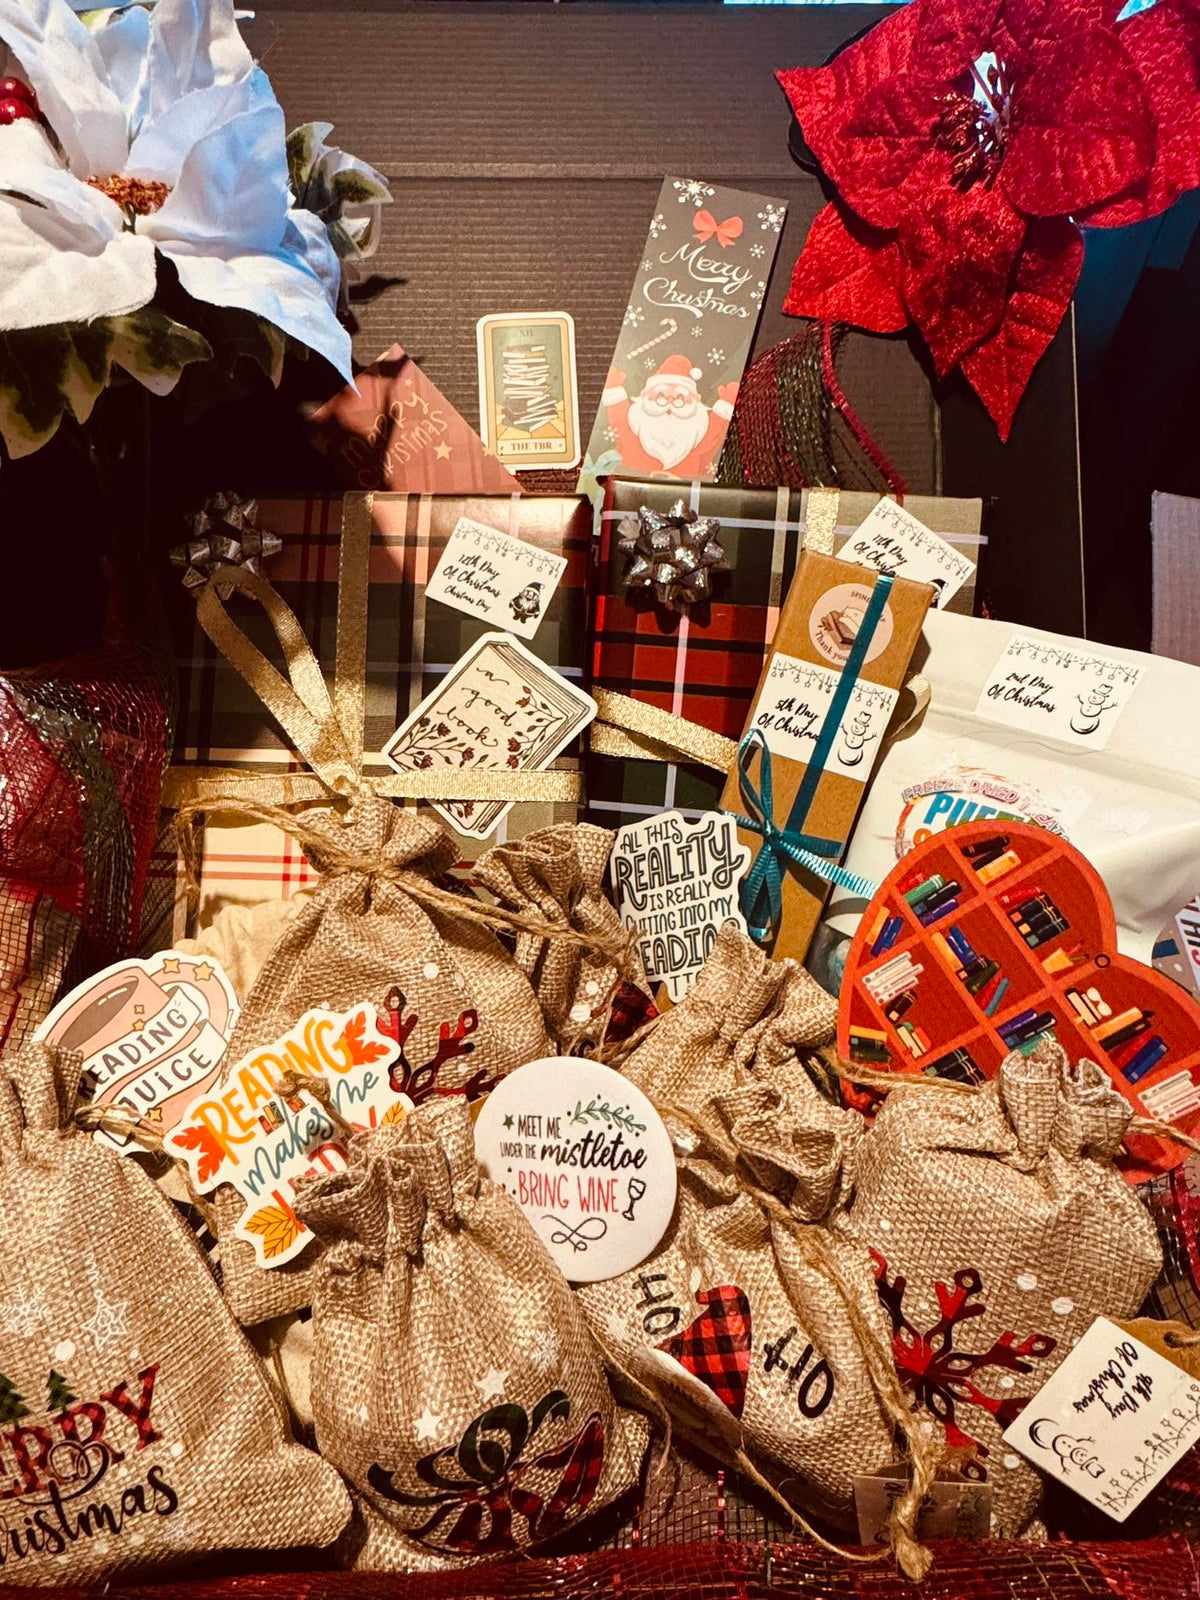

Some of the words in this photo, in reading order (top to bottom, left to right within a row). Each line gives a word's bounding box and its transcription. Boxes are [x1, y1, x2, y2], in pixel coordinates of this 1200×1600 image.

[659, 243, 753, 295] Merry
[643, 277, 751, 319] Christmas
[519, 328, 533, 337] XII
[511, 442, 531, 451] THE
[533, 441, 552, 450] TBR
[853, 541, 871, 555] Of
[888, 545, 907, 566] Day
[442, 565, 459, 580] Of
[456, 570, 502, 598] Christmas
[458, 554, 482, 567] 12th
[478, 560, 501, 581] Day
[815, 630, 833, 655] Thank
[476, 667, 510, 686] a
[1027, 675, 1055, 695] Day
[461, 687, 517, 727] good
[774, 697, 797, 712] 5th
[794, 702, 819, 725] Day
[987, 684, 1006, 700] Of
[1003, 686, 1057, 713] Christmas
[436, 706, 499, 747] book
[757, 712, 775, 729] Of
[620, 831, 642, 855] ALL
[643, 818, 684, 845] THIS
[614, 820, 745, 912] REALITY
[649, 893, 665, 912] IS
[665, 880, 712, 908] REALLY
[678, 903, 707, 929] INTO
[709, 894, 733, 920] MY
[517, 1114, 543, 1139] MEET
[546, 1116, 562, 1139] ME
[499, 1141, 523, 1159] UNDER
[524, 1144, 537, 1159] THE
[540, 1130, 648, 1171] mistletoe
[518, 1170, 570, 1209] BRING
[577, 1176, 619, 1213] WINE
[1114, 1341, 1139, 1368] Of
[1072, 1359, 1126, 1415] Christmas
[1104, 1391, 1140, 1421] Day
